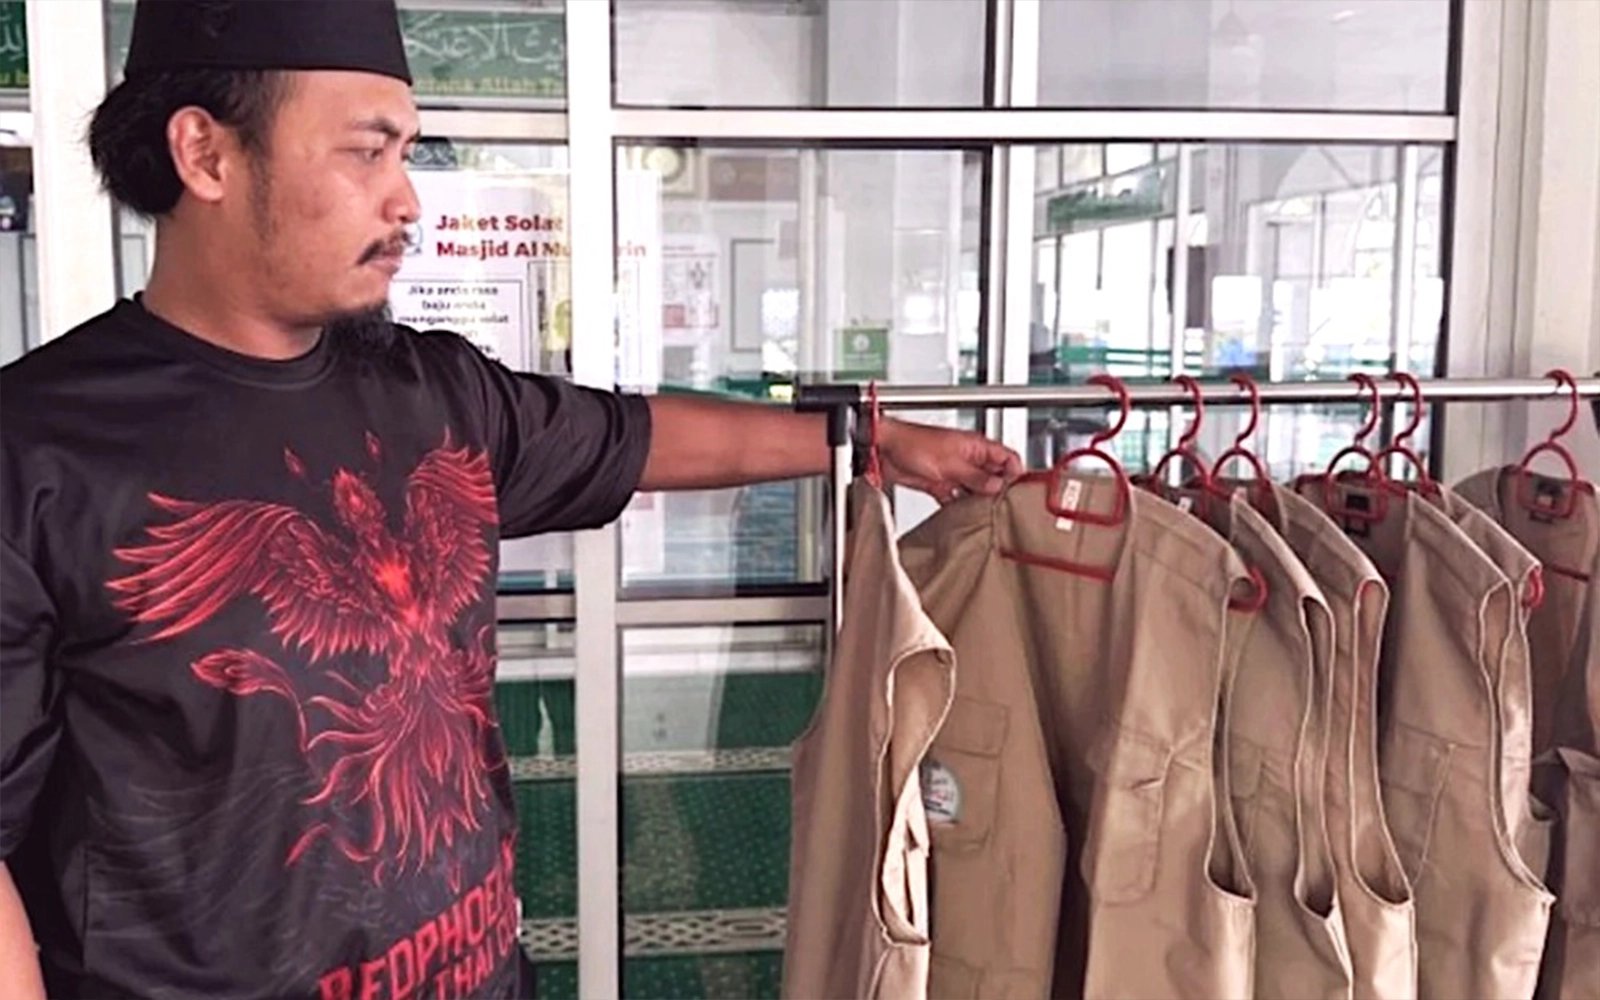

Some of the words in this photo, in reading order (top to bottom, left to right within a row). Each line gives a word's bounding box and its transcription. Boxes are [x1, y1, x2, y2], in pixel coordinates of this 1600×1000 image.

[436, 215, 499, 231] Jaket
[505, 214, 563, 231] Solat
[436, 240, 509, 261] Masjid
[514, 241, 538, 257] Al
[434, 936, 493, 1000] THAI
